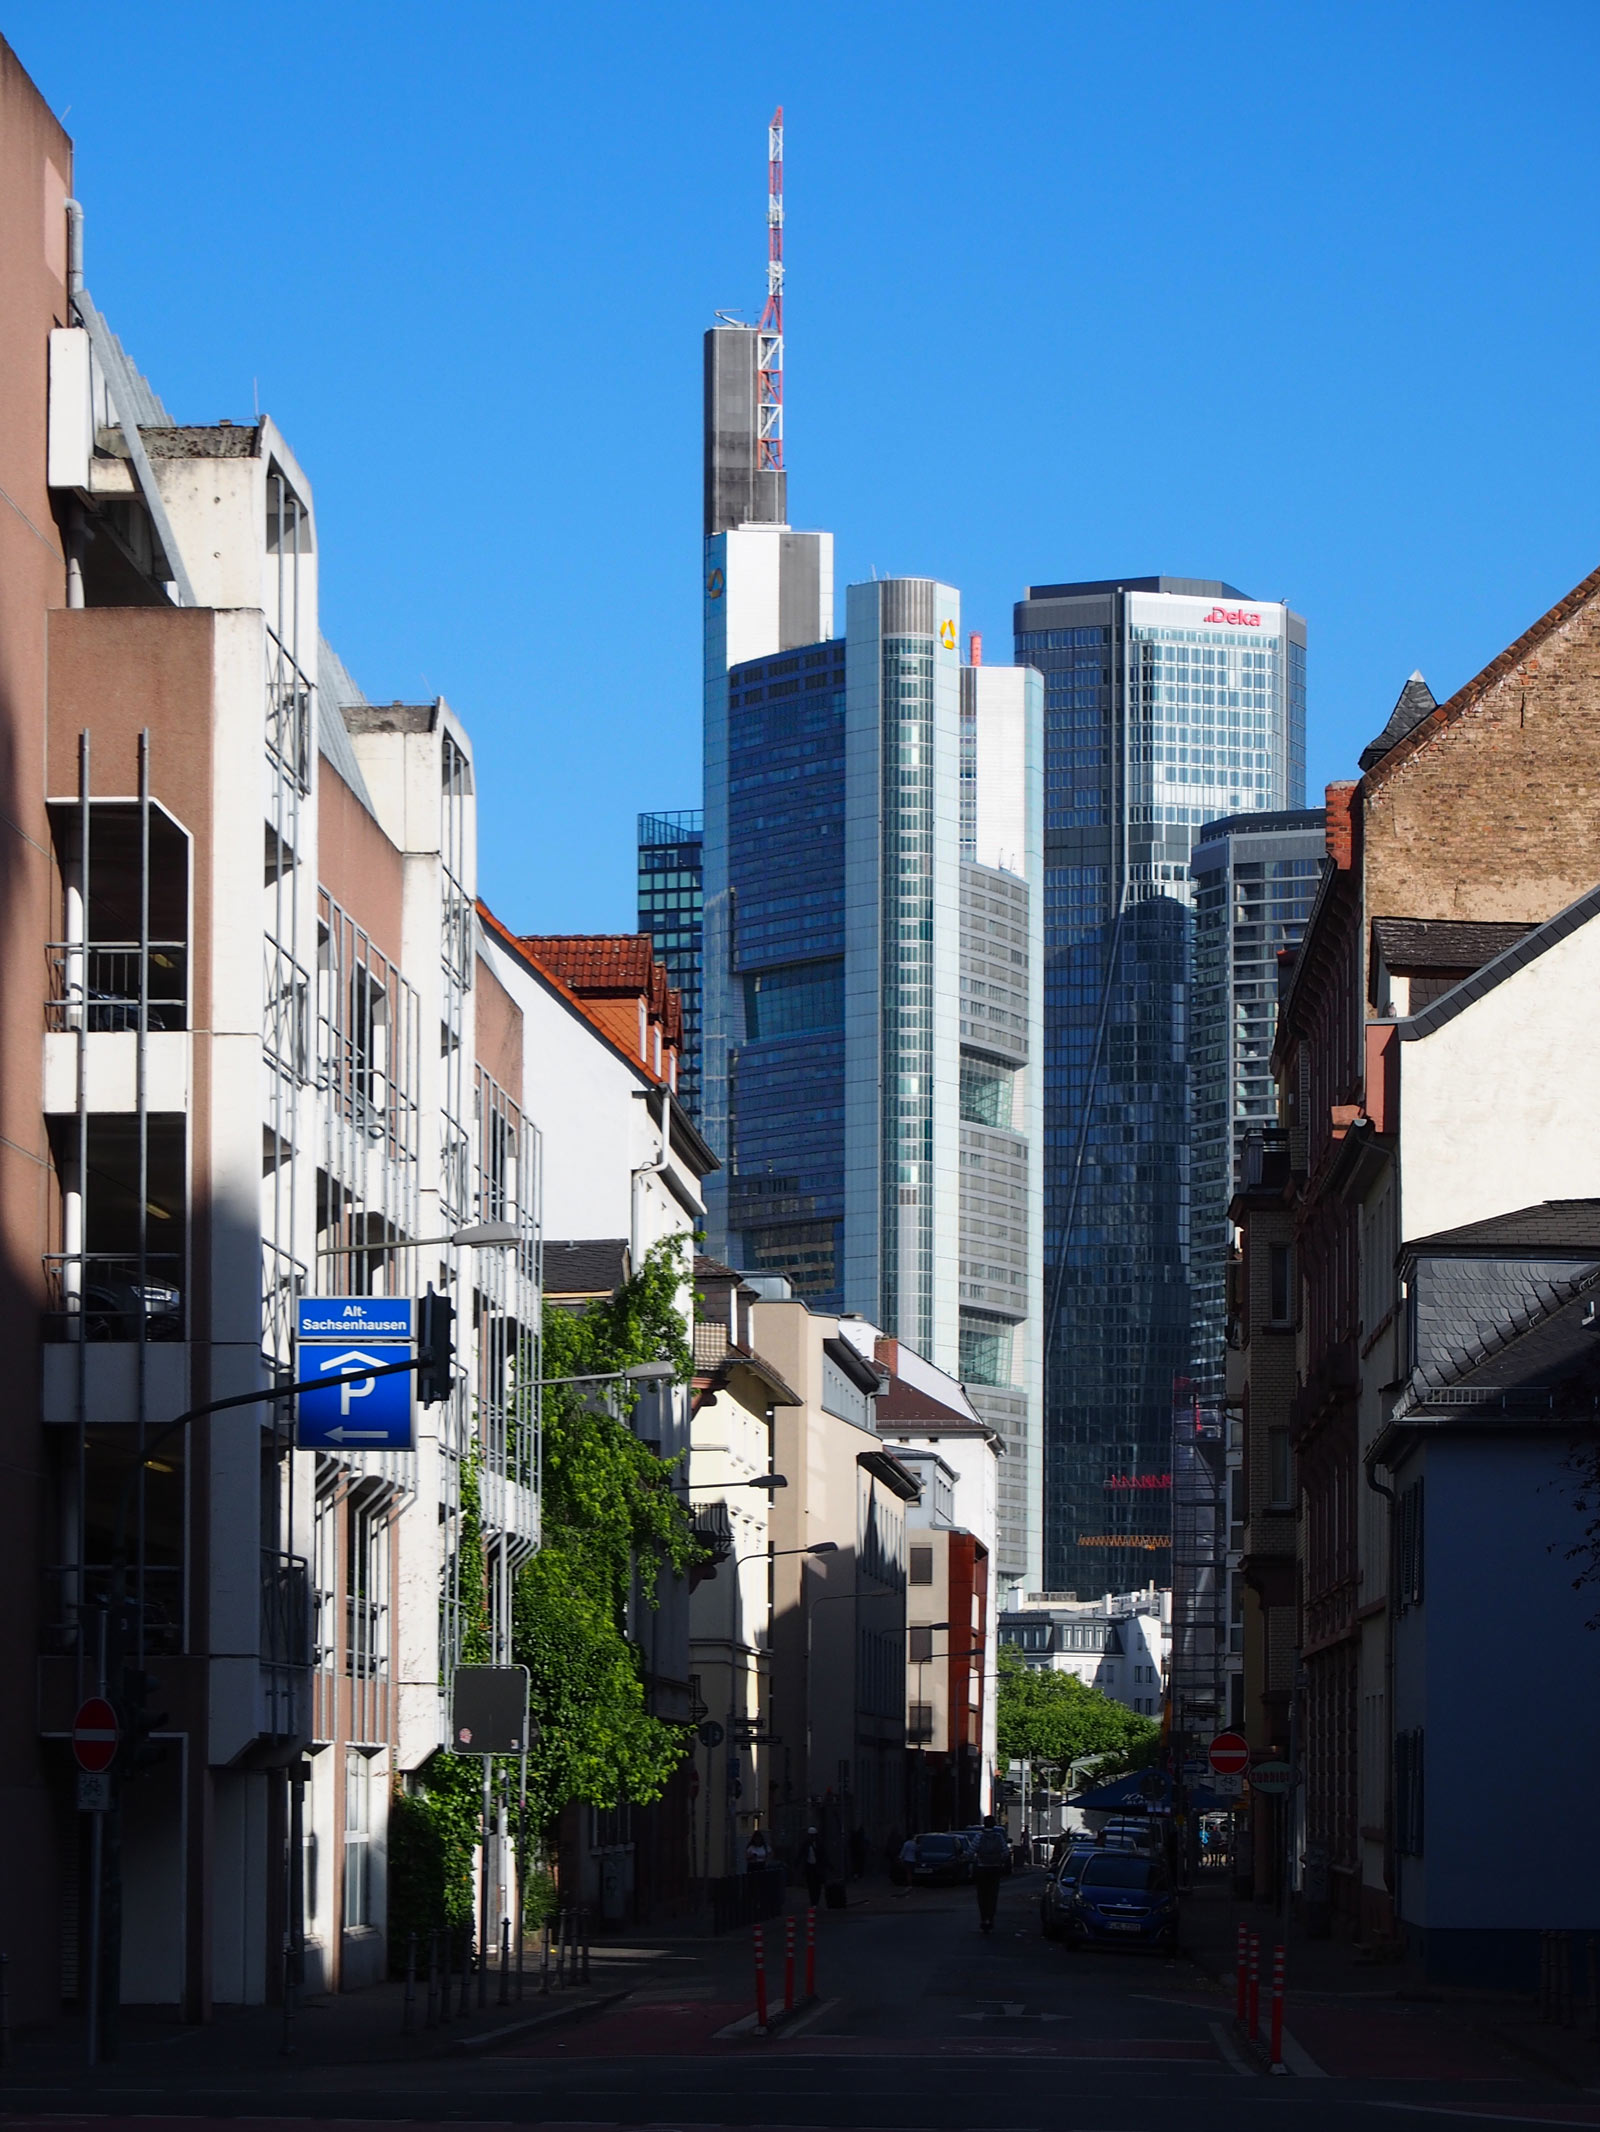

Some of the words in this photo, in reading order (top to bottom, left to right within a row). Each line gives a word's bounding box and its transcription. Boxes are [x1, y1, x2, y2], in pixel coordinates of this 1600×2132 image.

[1212, 606, 1262, 627] Deka
[342, 1305, 368, 1318] Alt-
[302, 1318, 408, 1331] Sachsenhausen
[340, 1367, 376, 1416] P
